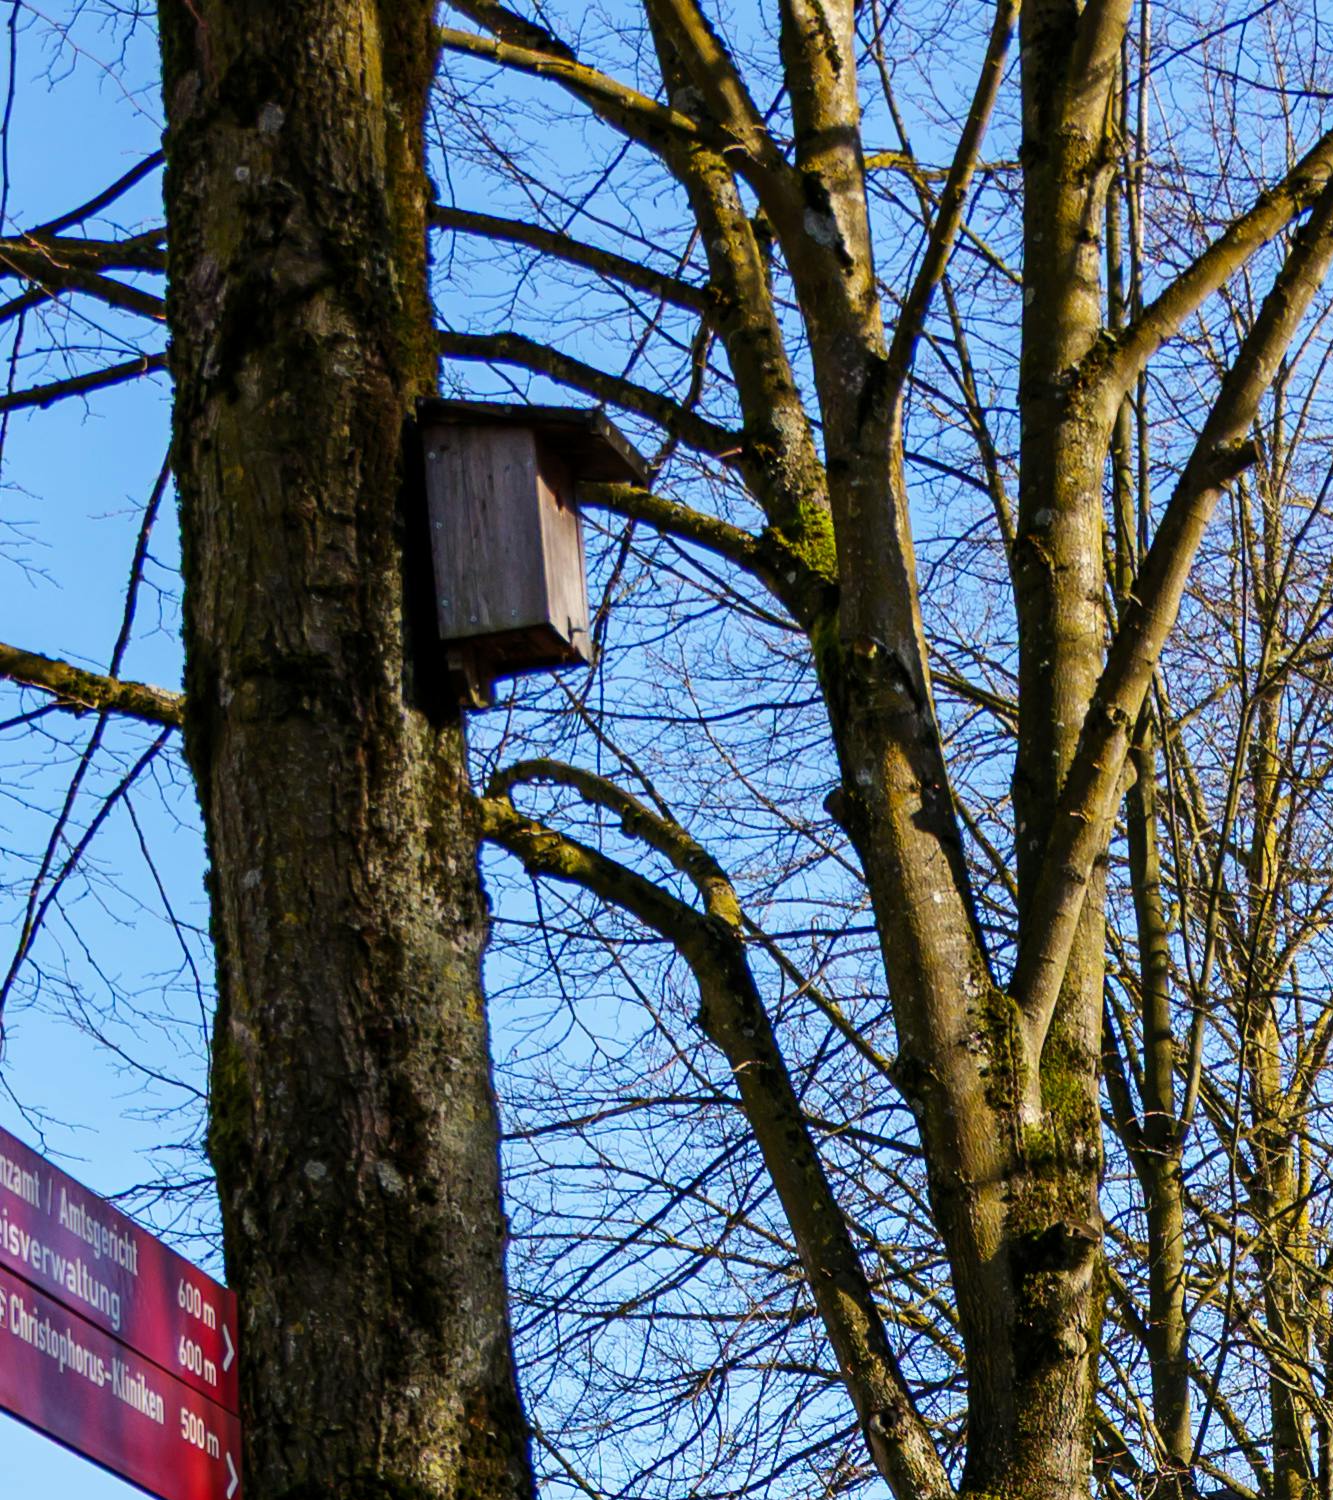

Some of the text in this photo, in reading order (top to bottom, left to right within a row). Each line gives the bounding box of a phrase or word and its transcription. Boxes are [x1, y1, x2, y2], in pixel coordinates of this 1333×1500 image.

[0, 1207, 217, 1388] isverwaltung 600 m
[59, 1187, 139, 1276] Amtsgericht
[178, 1278, 202, 1319] 600
[203, 1301, 216, 1331] m
[10, 1293, 220, 1460] Christophorus-Kliniken 500 m
